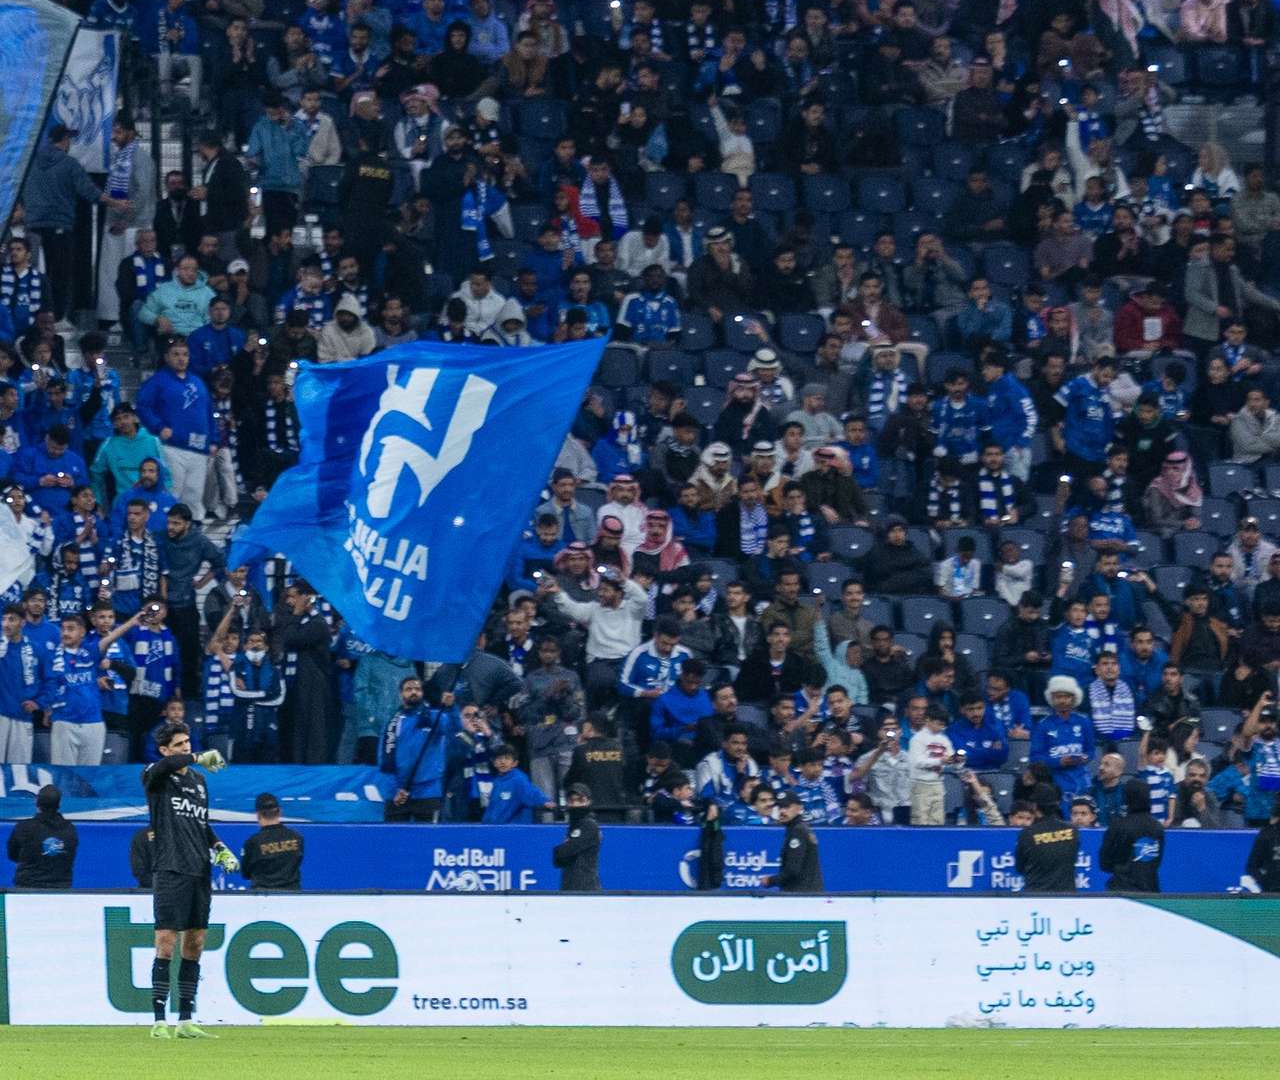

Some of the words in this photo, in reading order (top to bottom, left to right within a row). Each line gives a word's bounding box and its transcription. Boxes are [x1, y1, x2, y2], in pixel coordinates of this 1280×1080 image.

[171, 797, 207, 819] SAVVY
[260, 839, 299, 855] POLICE
[1033, 828, 1073, 845] POLICE
[433, 848, 467, 868] Red
[470, 848, 505, 868] Bull
[990, 871, 1024, 891] Riy
[976, 919, 1010, 947] تبي
[1059, 917, 1095, 942] على
[692, 932, 754, 982] الآن
[1034, 952, 1052, 972] ما
[1059, 952, 1096, 977] وين
[413, 993, 529, 1012] tree.com.sa
[978, 991, 1012, 1015] تبي
[1019, 990, 1037, 1009] ما
[1043, 990, 1096, 1014] وكيف
